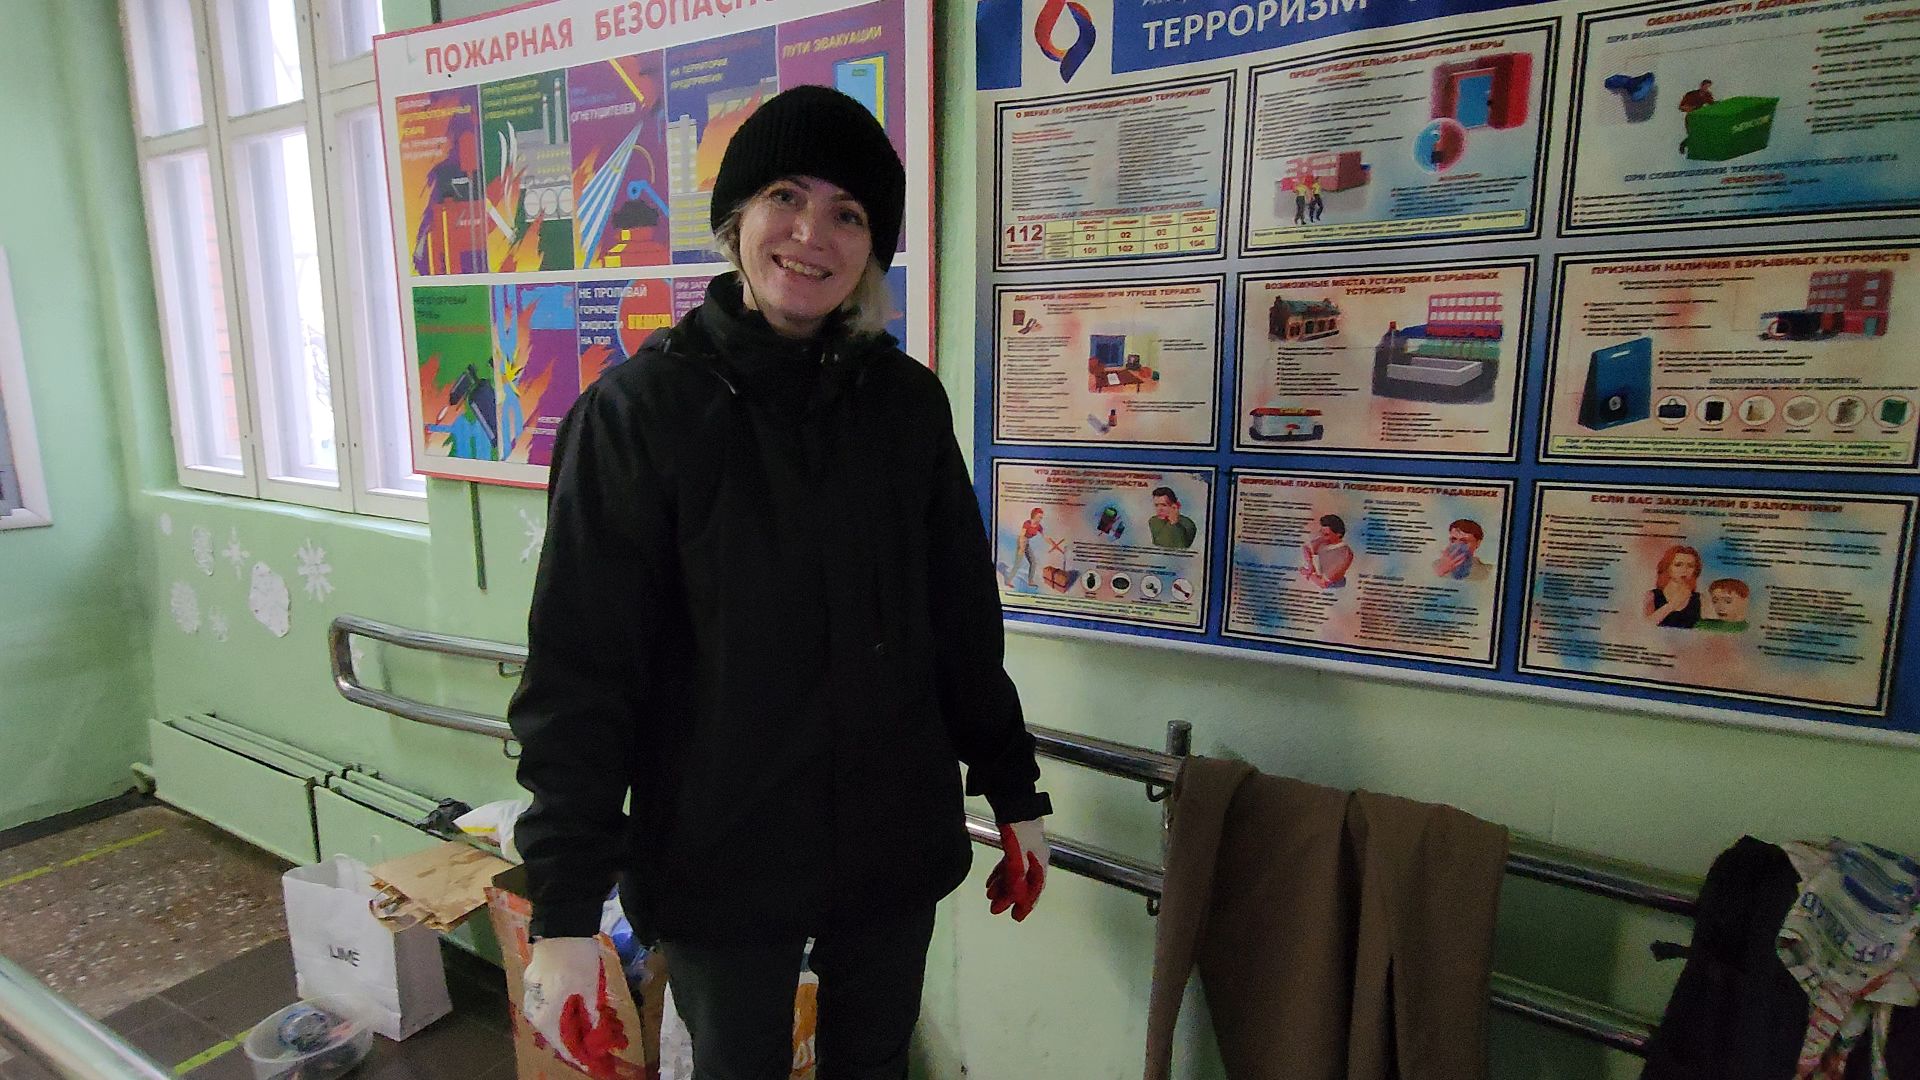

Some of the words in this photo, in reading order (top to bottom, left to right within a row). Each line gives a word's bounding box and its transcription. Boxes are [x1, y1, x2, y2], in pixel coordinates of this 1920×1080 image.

[425, 18, 573, 74] ПОЖАРНАЯ
[1006, 223, 1043, 243] 112
[1120, 231, 1131, 239] 02
[579, 288, 591, 298] НЕ
